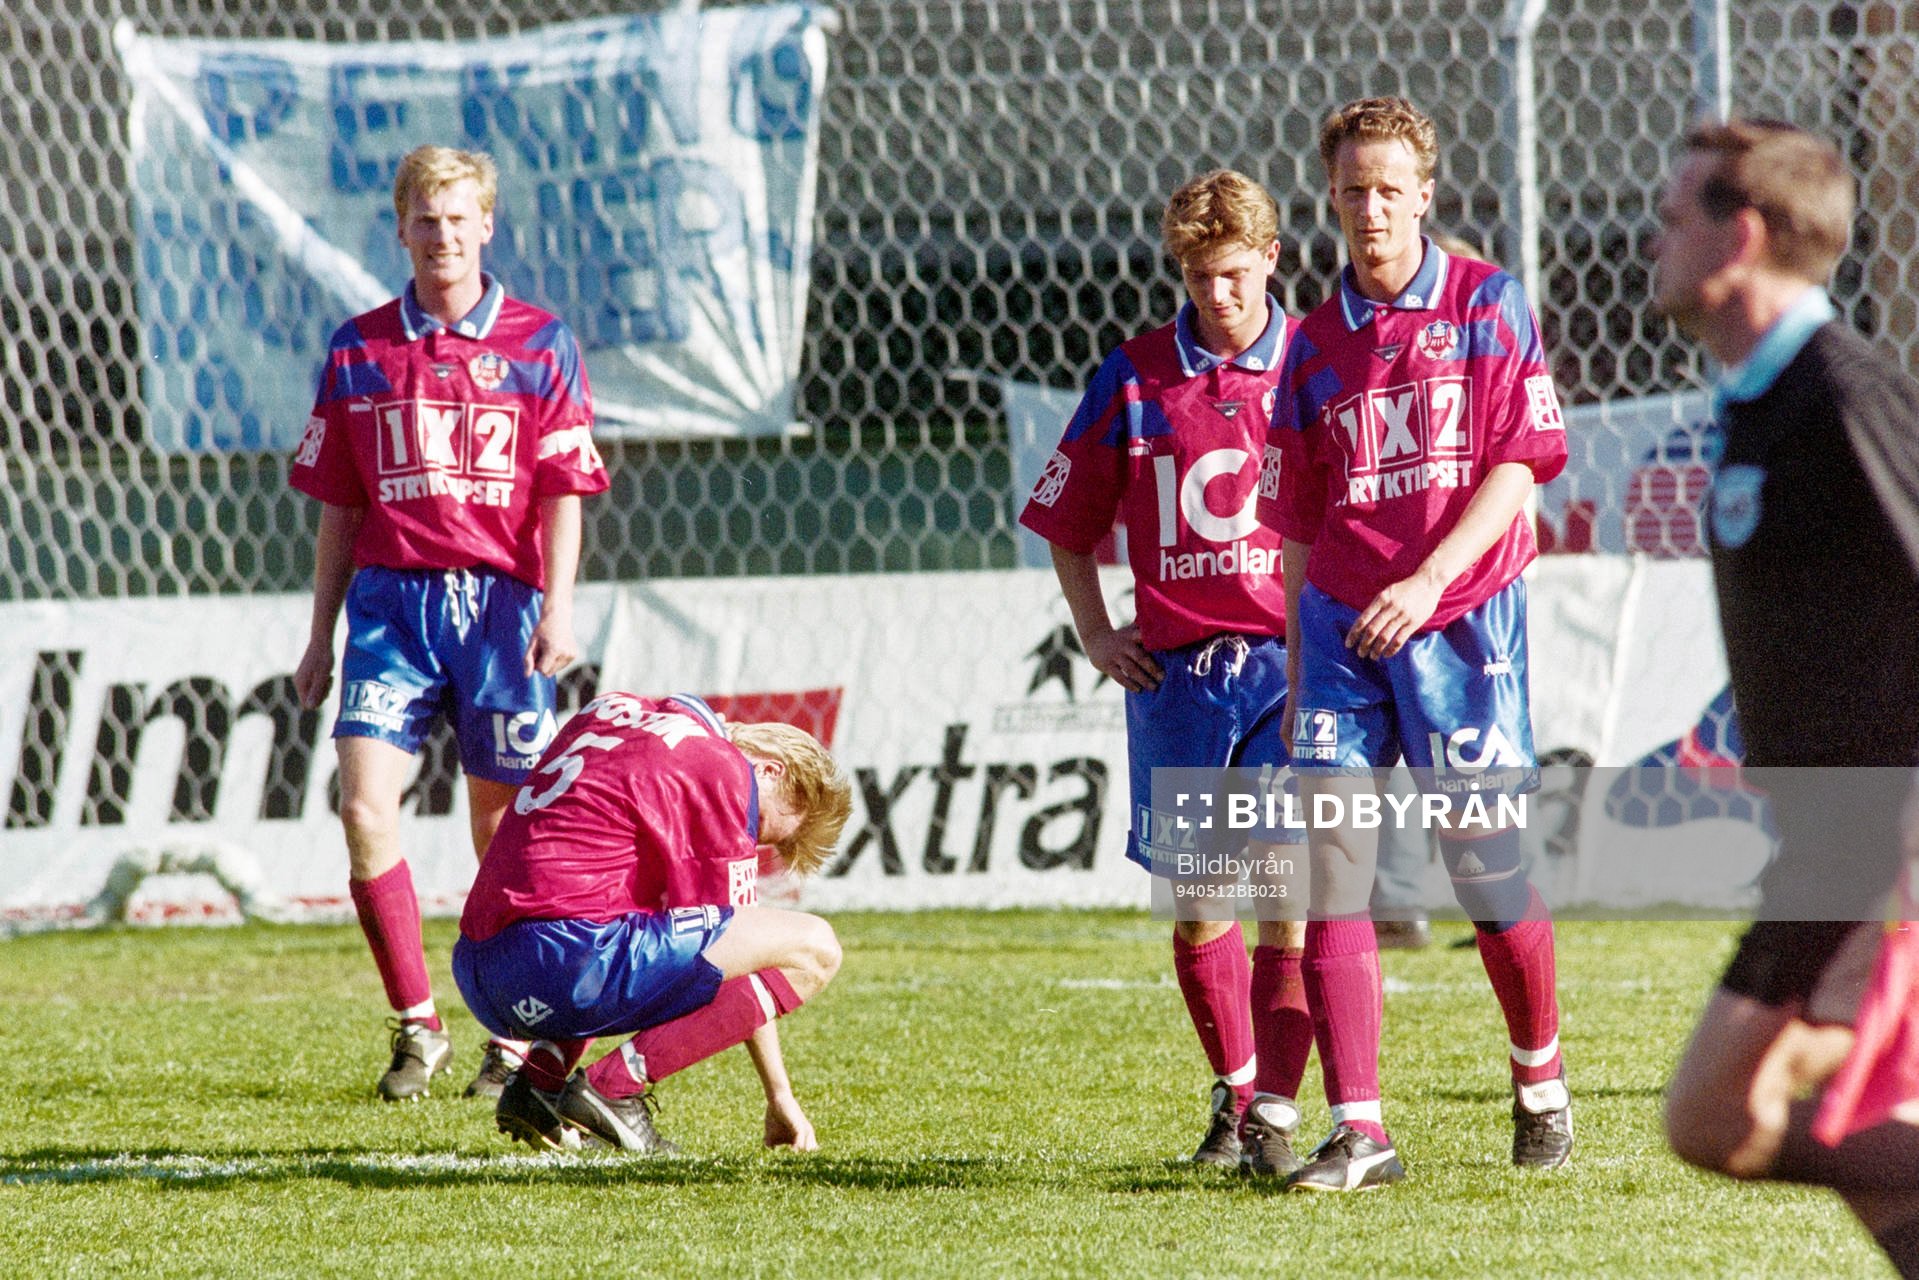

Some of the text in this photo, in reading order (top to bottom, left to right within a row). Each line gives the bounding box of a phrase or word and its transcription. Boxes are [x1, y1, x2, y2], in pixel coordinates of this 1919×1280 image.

[384, 407, 513, 471] 1X2
[1153, 448, 1261, 548] IC
[1335, 460, 1473, 507] RYKTIPSET
[1159, 540, 1284, 582] handlar
[1295, 710, 1337, 744] X2
[1428, 723, 1524, 776] ICA
[514, 731, 625, 815] 5
[826, 722, 1109, 881] xtra
[511, 995, 550, 1023] ICA
